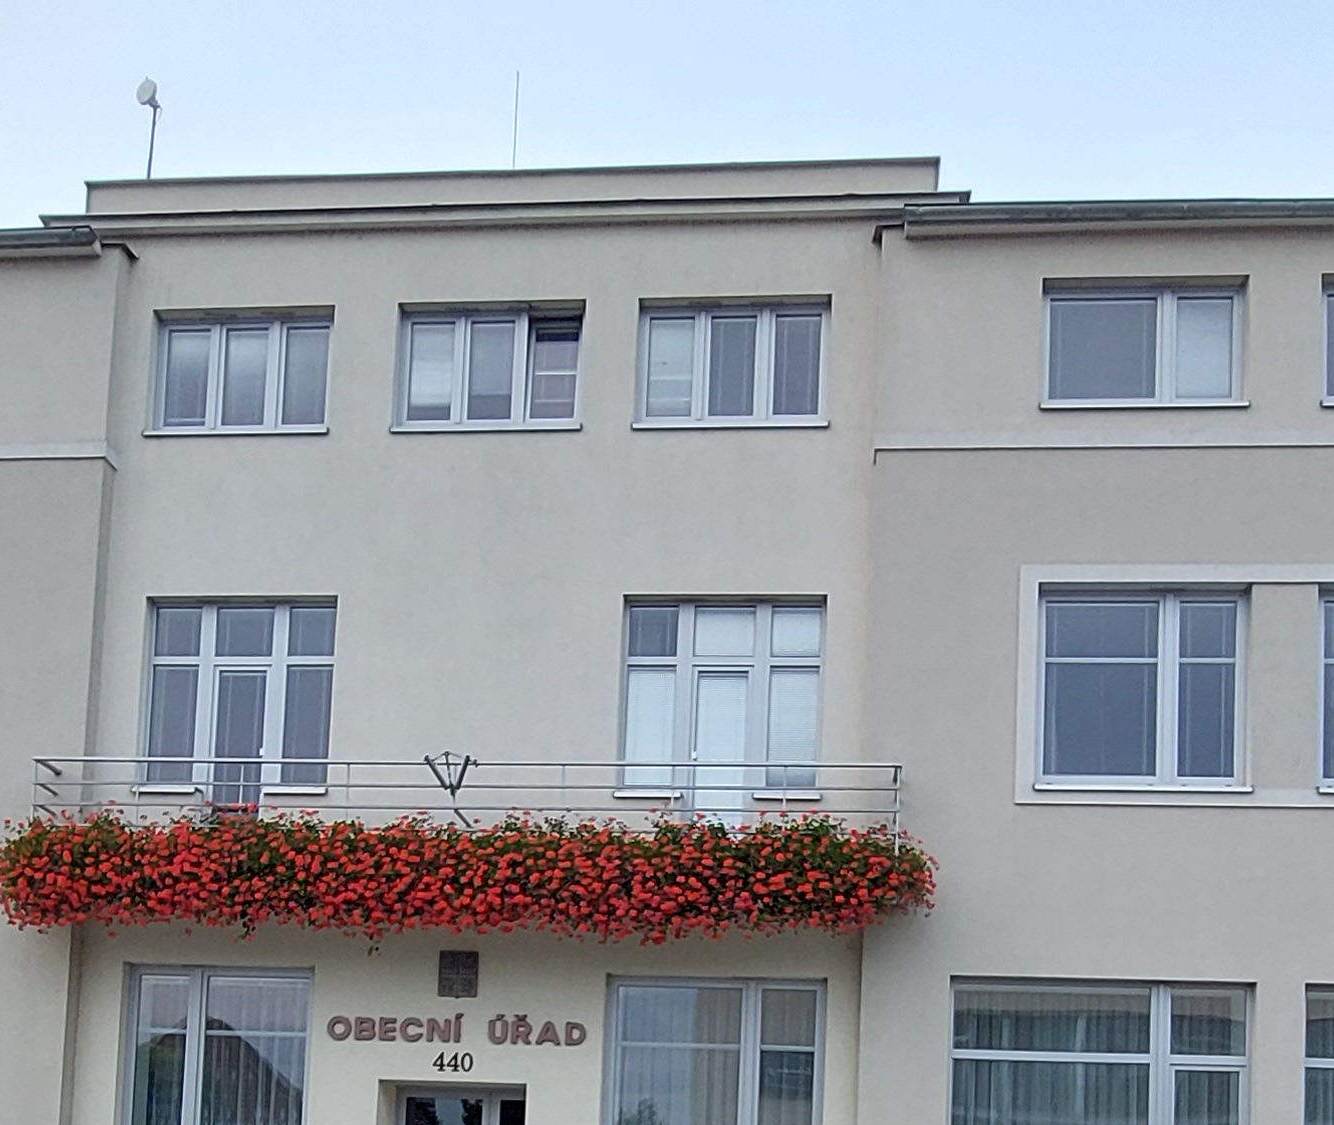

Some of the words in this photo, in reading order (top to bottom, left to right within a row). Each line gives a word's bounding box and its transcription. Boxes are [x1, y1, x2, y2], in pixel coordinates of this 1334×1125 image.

[327, 1013, 464, 1043] OBECNÍ
[488, 1014, 587, 1046] ÚŘAD
[432, 1052, 474, 1073] 440
